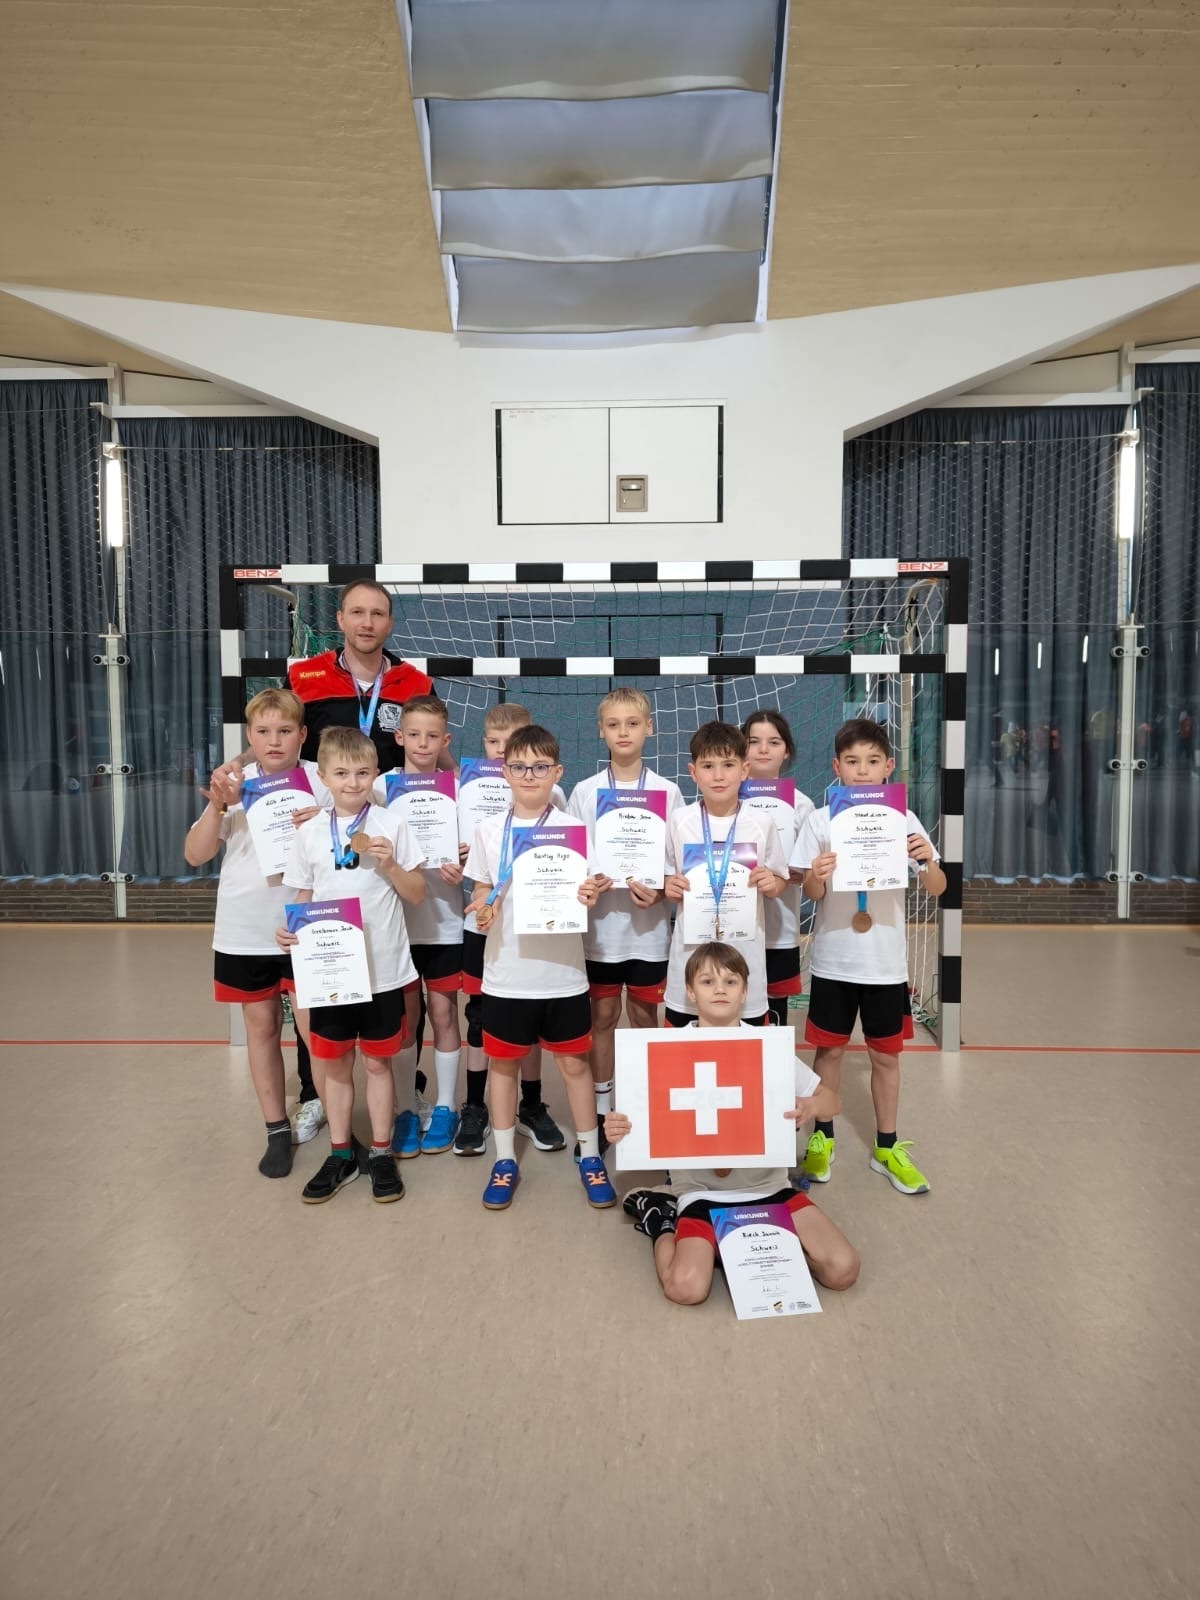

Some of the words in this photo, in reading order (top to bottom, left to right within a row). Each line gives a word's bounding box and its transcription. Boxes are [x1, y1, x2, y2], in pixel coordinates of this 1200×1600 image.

[898, 562, 945, 571] BENZ
[234, 569, 280, 578] BENZ
[258, 777, 290, 790] URKUNDE
[306, 907, 340, 916] URKUNDE
[734, 1211, 769, 1220] URKUNDE
